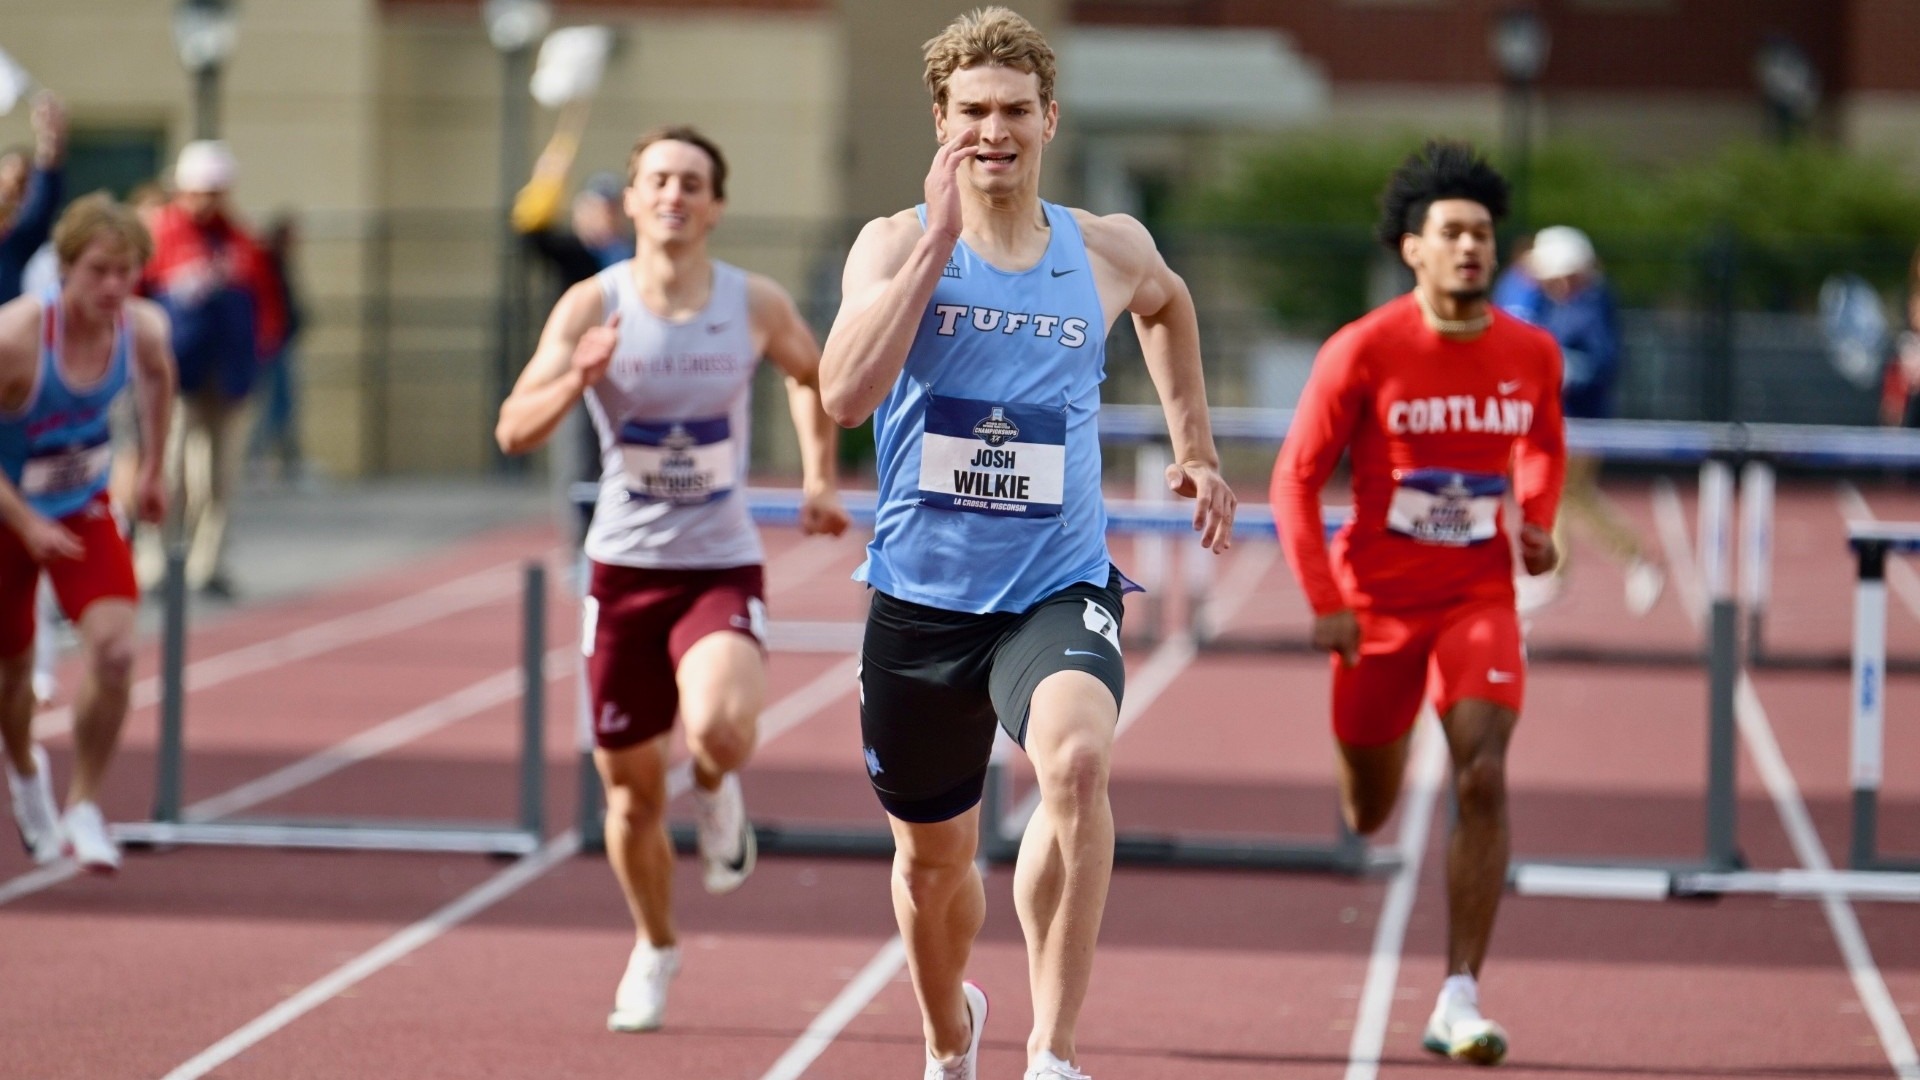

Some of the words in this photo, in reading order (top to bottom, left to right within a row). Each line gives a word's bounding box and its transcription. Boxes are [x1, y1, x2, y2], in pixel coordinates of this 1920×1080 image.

[935, 303, 1089, 348] TUFTS
[1387, 395, 1534, 436] CORTLAND
[974, 427, 1018, 437] CHAMPIONSHIPS
[970, 448, 1016, 469] JOSH
[953, 469, 1031, 500] WILKIE
[953, 497, 962, 506] LA
[990, 502, 1028, 512] WISCONSIN
